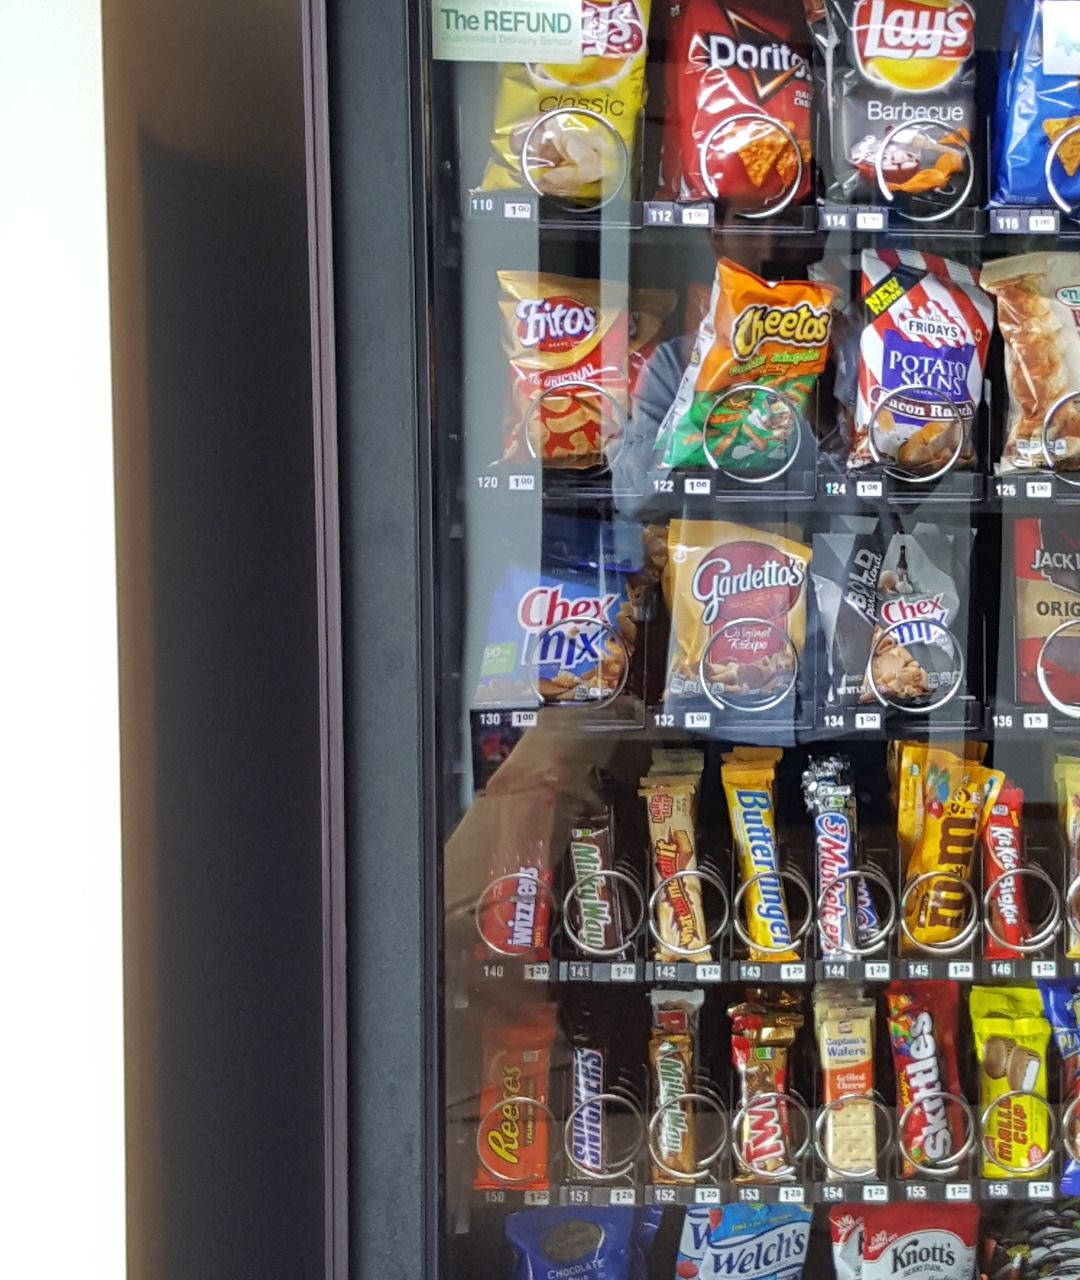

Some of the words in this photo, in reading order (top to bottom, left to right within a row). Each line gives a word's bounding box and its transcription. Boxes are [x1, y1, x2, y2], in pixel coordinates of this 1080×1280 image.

[441, 8, 479, 31] The
[484, 10, 572, 33] REFUND
[863, 0, 968, 60] Lay's
[538, 94, 625, 117] Classic
[867, 101, 964, 121] Barbecue
[471, 199, 494, 211] 110
[650, 210, 671, 222] 112
[826, 214, 846, 227] 114
[997, 217, 1019, 230] 116
[865, 276, 901, 309] NEW
[515, 298, 597, 347] Fritos
[734, 302, 831, 361] Cheetos
[889, 350, 967, 381] POTATO
[901, 371, 962, 396] SKINS
[477, 477, 498, 488] 120
[653, 480, 674, 492] 122
[826, 483, 846, 495] 124
[995, 485, 1016, 496] 126
[1031, 550, 1075, 571] JACK
[693, 558, 804, 625] Gardetto's
[520, 588, 617, 628] Chex
[882, 593, 945, 625] Chex
[723, 625, 773, 643] Original
[524, 627, 610, 666] mix
[727, 637, 769, 654] Recipe
[479, 714, 500, 725] 130
[654, 715, 674, 726] 132
[824, 716, 845, 727] 134
[992, 716, 1013, 727] 136
[822, 816, 846, 839] 3
[570, 841, 606, 901] Milky
[735, 790, 793, 946] Butterfinger
[817, 836, 849, 952] Musketeers
[507, 866, 539, 948] Twizzlers
[580, 901, 611, 949] Way
[483, 966, 504, 977] 140
[570, 966, 590, 977] 141
[656, 965, 676, 977] 142
[740, 965, 761, 977] 143
[824, 965, 845, 976] 144
[908, 964, 929, 976] 145
[991, 964, 1011, 975] 146
[825, 1036, 867, 1048] Captain's
[826, 1047, 867, 1058] Wafers
[836, 1072, 866, 1083] Grilled
[836, 1081, 867, 1091] Cheese
[906, 1011, 952, 1159] Skittles
[487, 1064, 521, 1164] Reese's
[573, 1047, 603, 1169] SNICKERS
[663, 1109, 689, 1153] Way
[743, 1095, 785, 1164] TWI
[997, 1096, 1013, 1162] MALLO
[1013, 1104, 1028, 1145] CUP
[484, 1191, 505, 1203] 150
[569, 1190, 590, 1203] 151
[655, 1189, 676, 1201] 152
[739, 1188, 760, 1200] 153
[823, 1186, 844, 1198] 154
[906, 1185, 927, 1197] 155
[988, 1184, 1009, 1196] 156
[712, 1229, 806, 1274] Welch's
[890, 1238, 956, 1275] Knott's
[546, 1258, 605, 1280] CHOCOLATE
